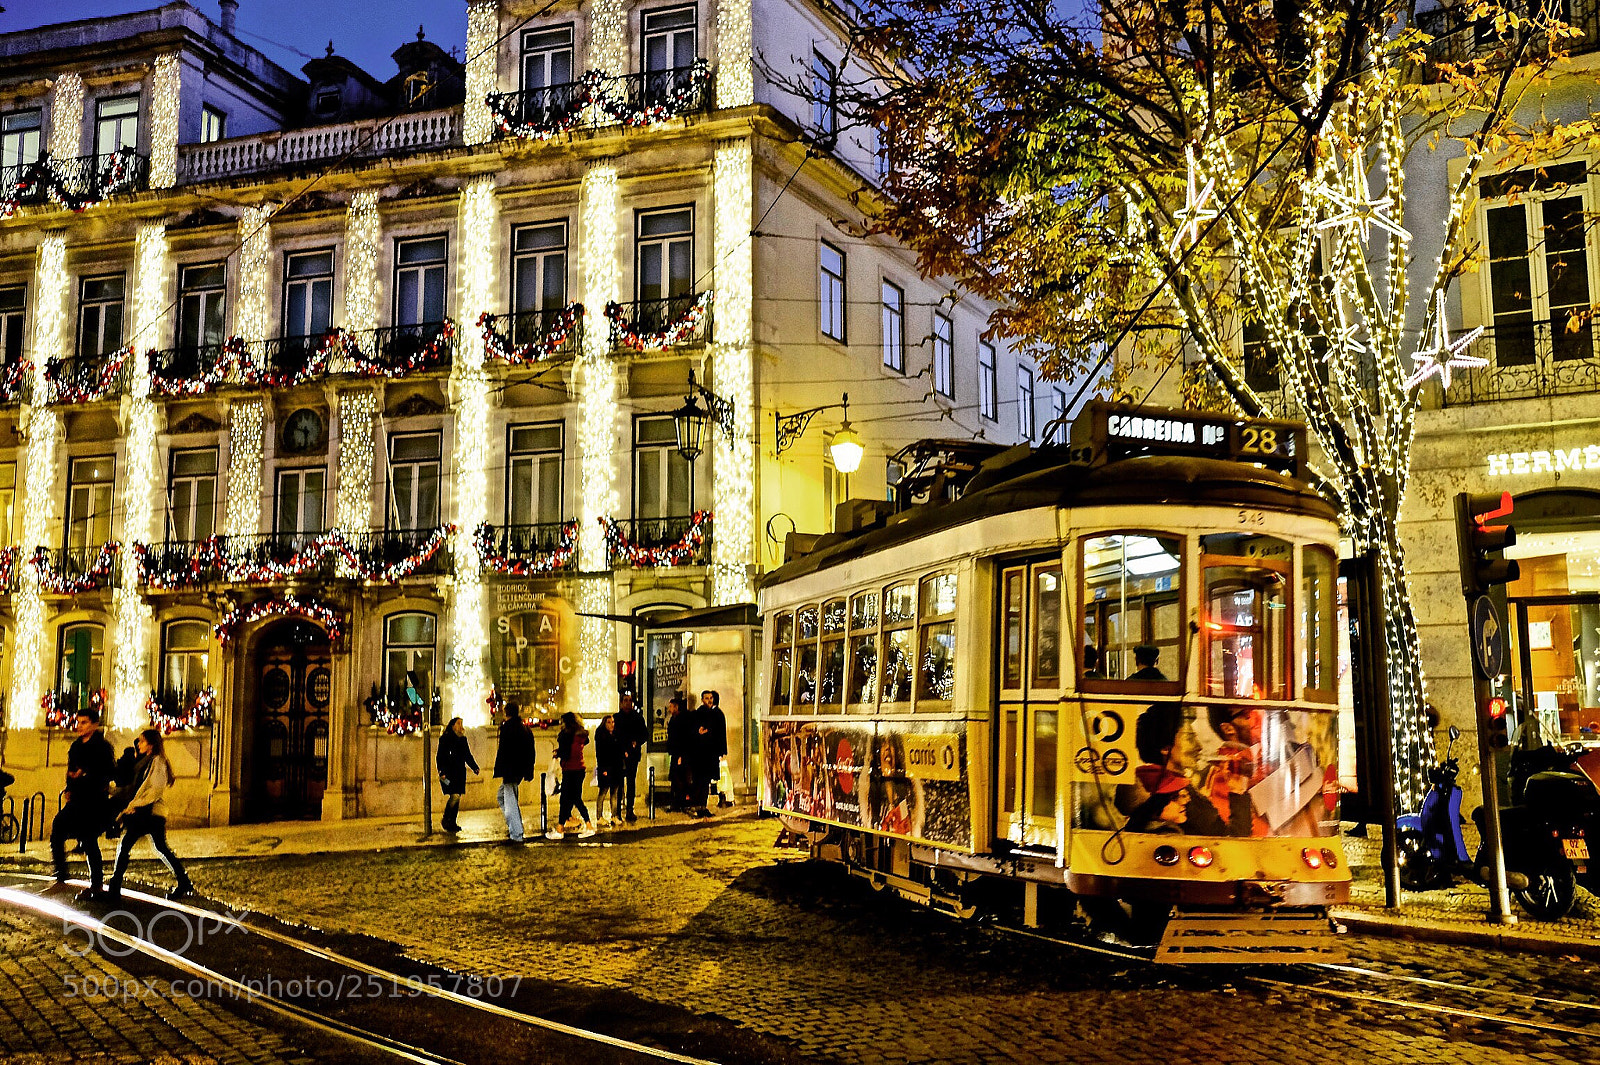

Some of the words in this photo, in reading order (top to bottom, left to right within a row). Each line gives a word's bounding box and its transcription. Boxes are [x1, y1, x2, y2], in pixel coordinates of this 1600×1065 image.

[1108, 415, 1195, 443] CARREIRA
[1241, 427, 1278, 454] 28
[496, 584, 528, 592] RODRIGO
[497, 615, 510, 634] S
[539, 614, 553, 633] A
[515, 636, 528, 654] P
[656, 649, 679, 662] NÃO
[558, 656, 572, 674] C
[657, 668, 664, 677] O
[665, 664, 686, 675] LIXO
[909, 743, 936, 767] carris
